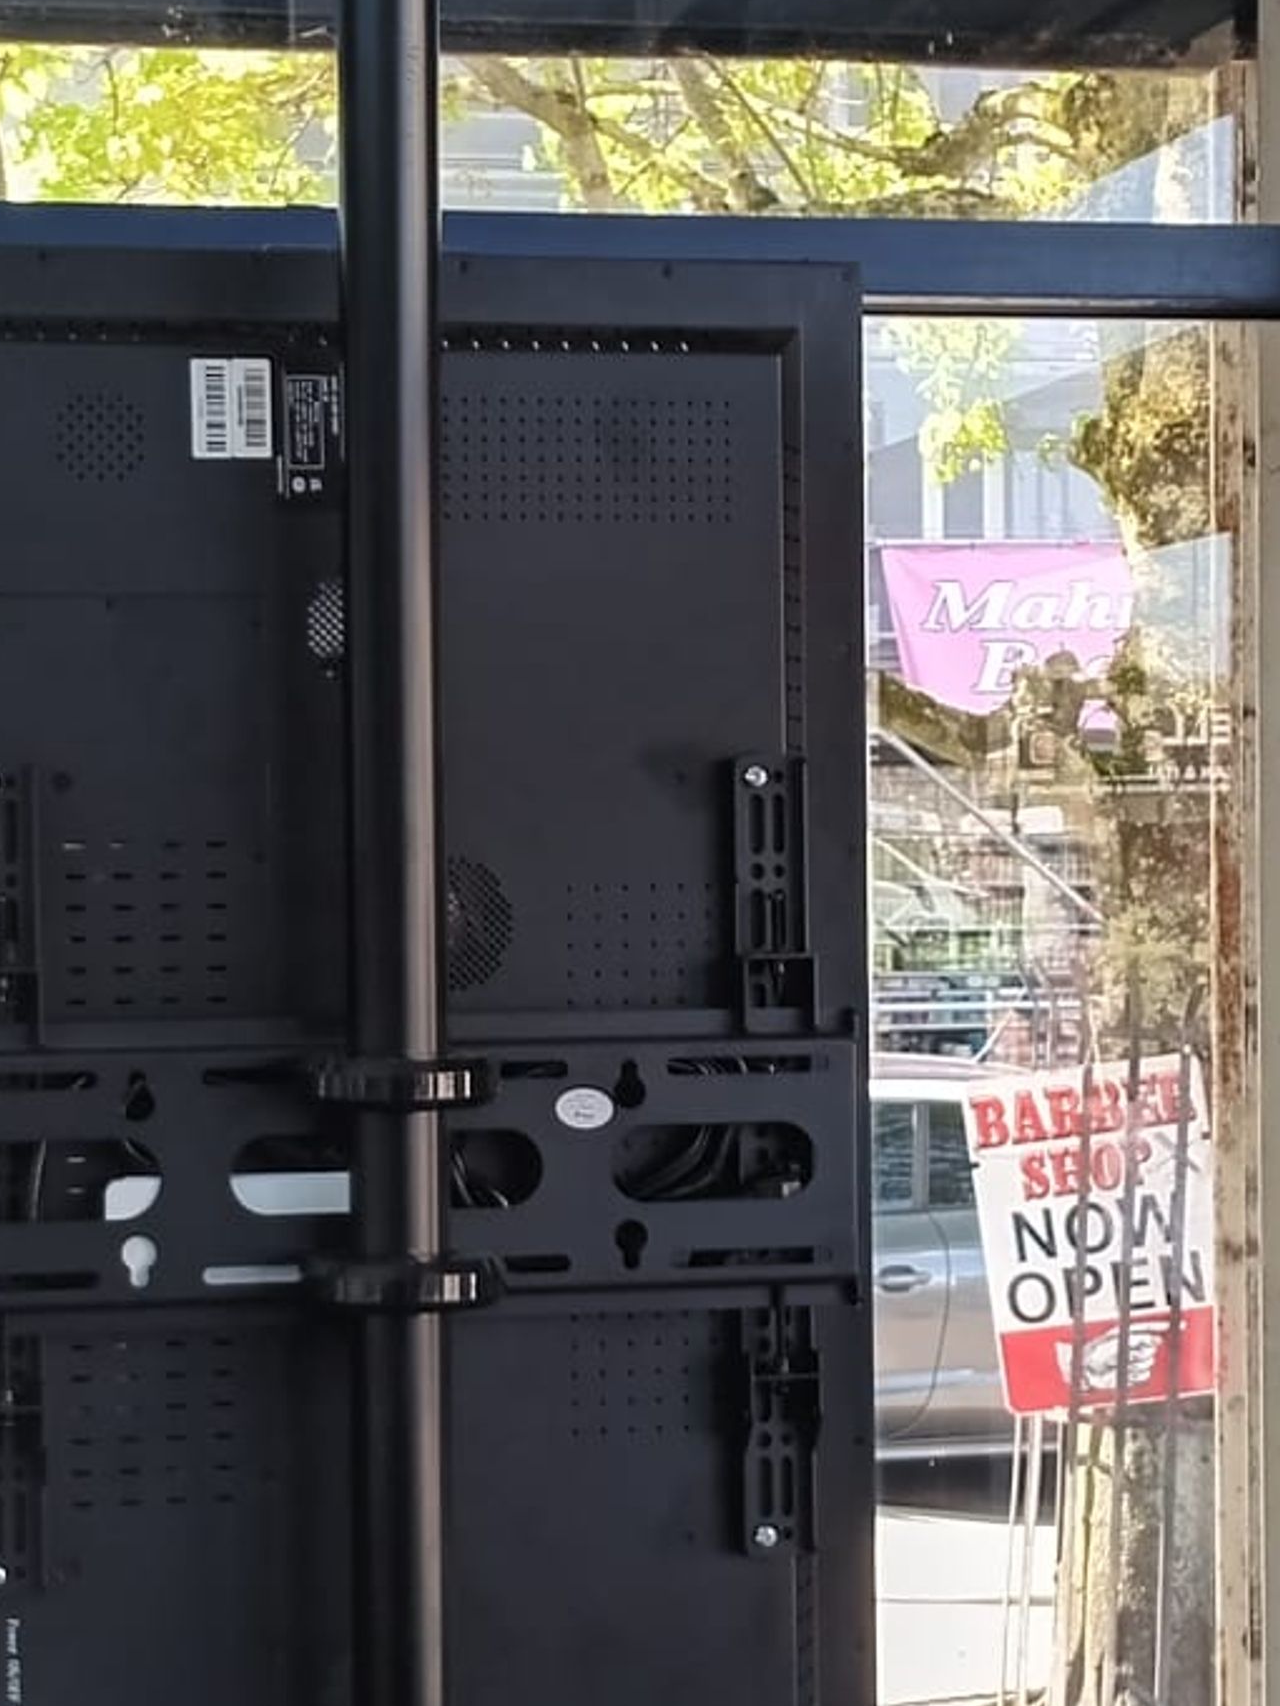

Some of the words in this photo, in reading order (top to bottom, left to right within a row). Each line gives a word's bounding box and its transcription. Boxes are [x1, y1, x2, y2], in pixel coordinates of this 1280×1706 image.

[1021, 1139, 1152, 1200] SHOP
[1011, 1193, 1180, 1263] NOW
[1007, 1250, 1206, 1324] OPEN
